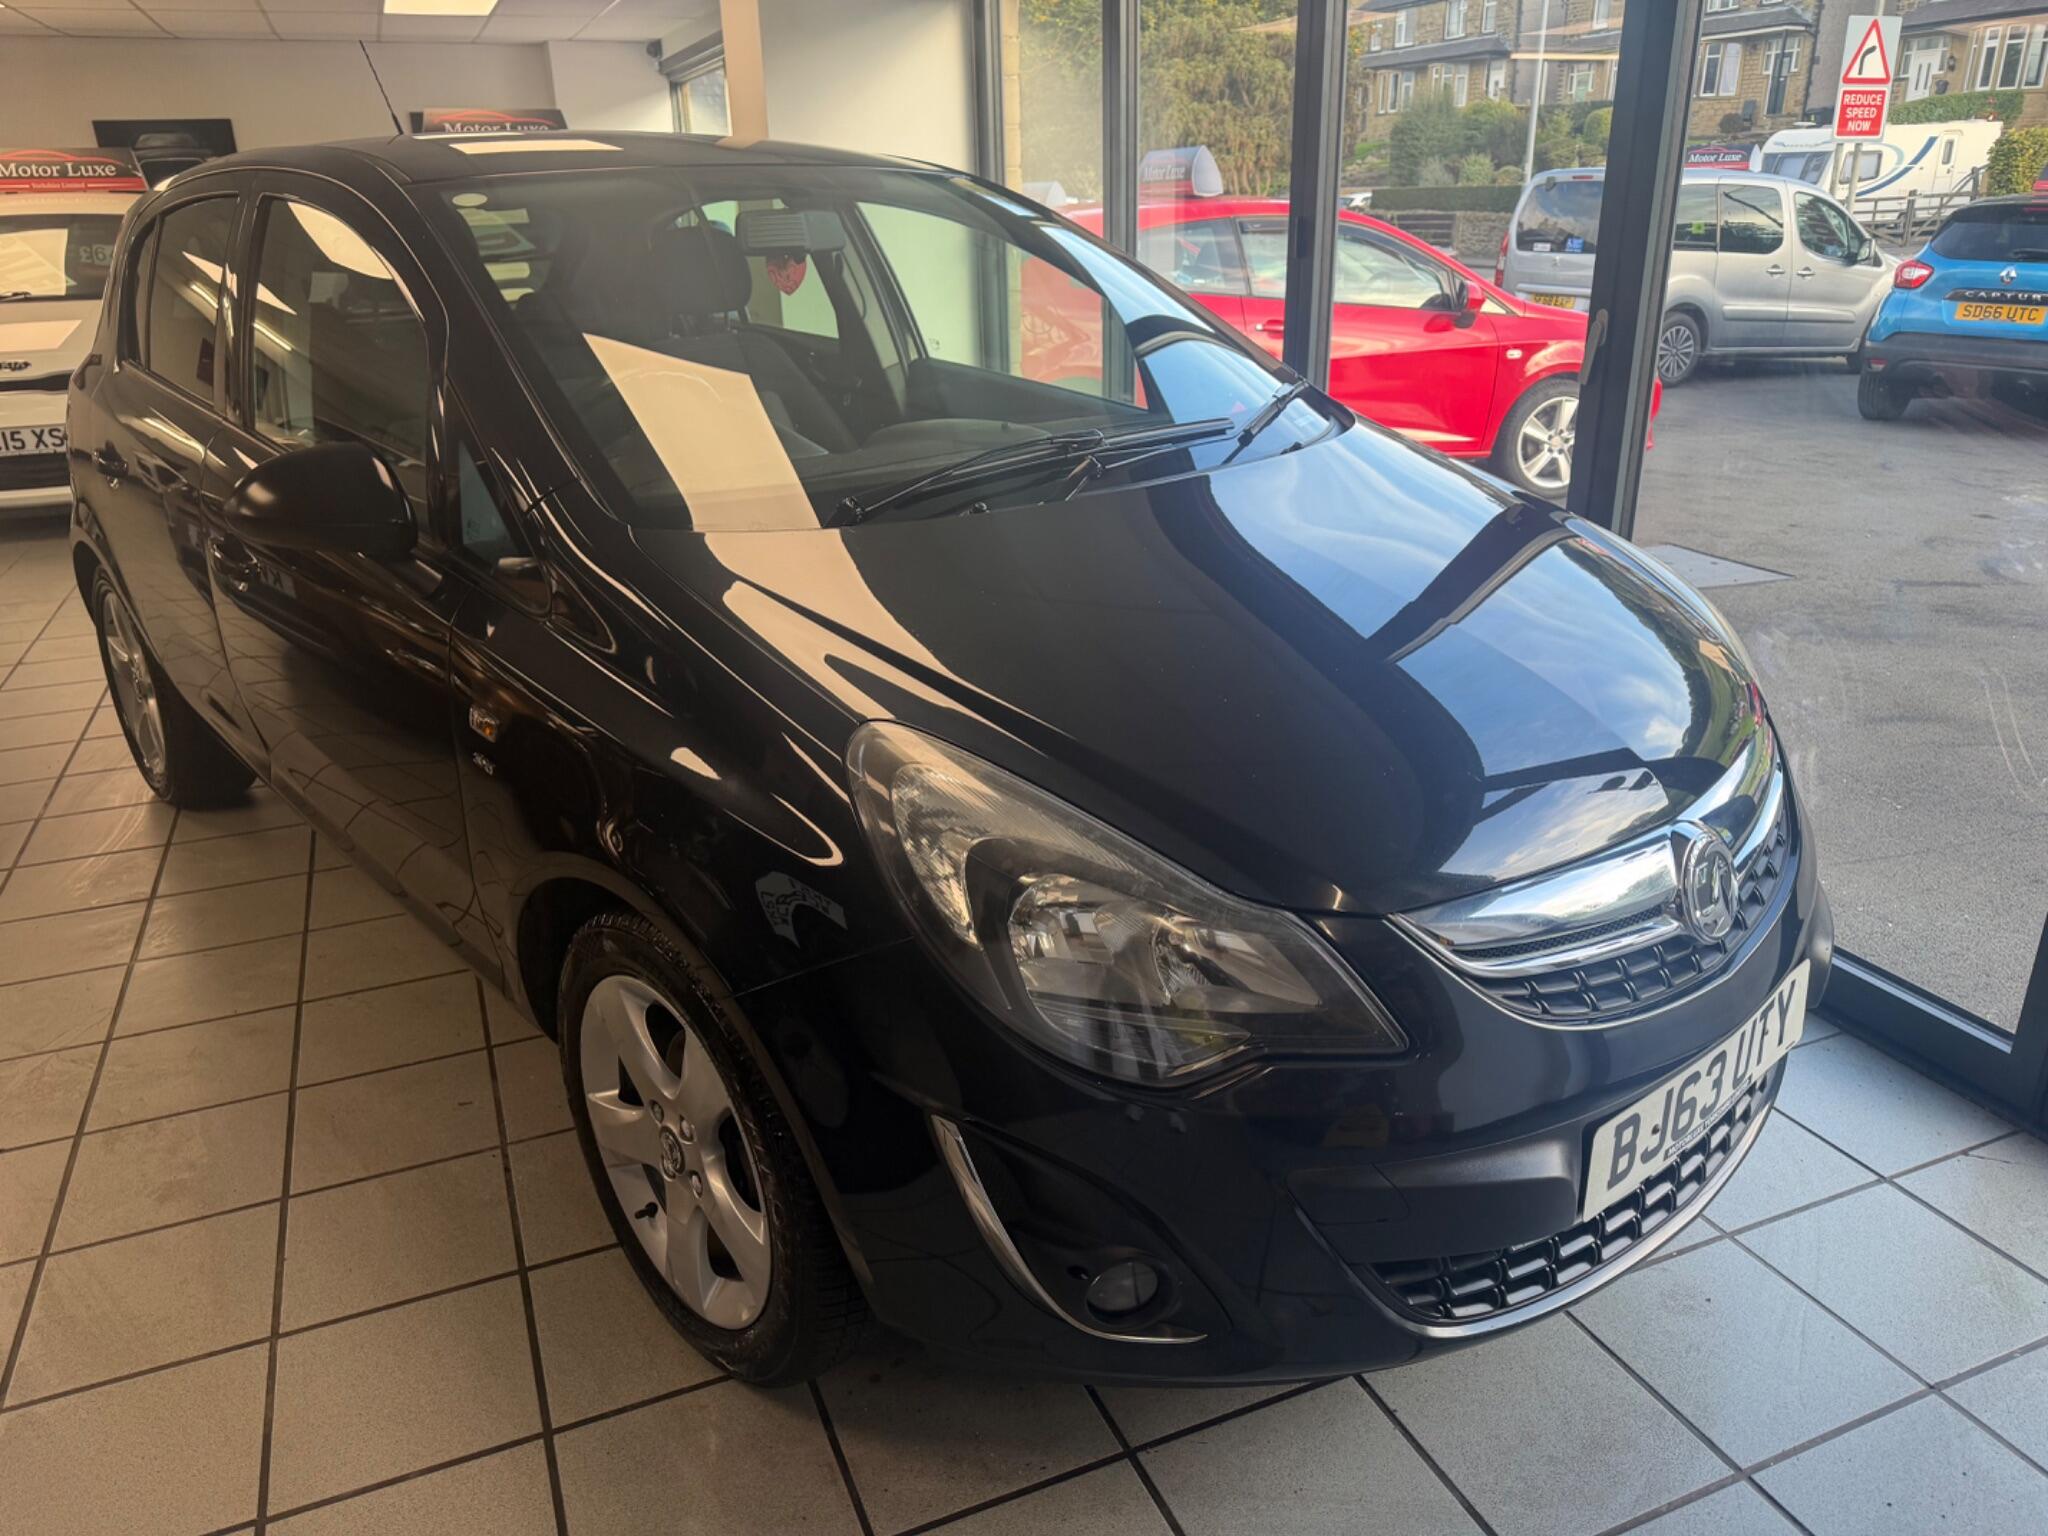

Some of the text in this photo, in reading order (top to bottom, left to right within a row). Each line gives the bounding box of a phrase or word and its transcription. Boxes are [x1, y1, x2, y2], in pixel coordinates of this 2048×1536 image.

[1843, 93, 1883, 106] REDUCE
[1845, 106, 1877, 119] SPEED
[1847, 120, 1872, 132] NOW
[1688, 153, 1717, 163] Motor
[0, 161, 117, 178] Motor Luxe
[1962, 304, 2040, 322] SD66 UTC
[0, 430, 26, 451] 15
[1607, 979, 1797, 1190] BJ63 UFY
